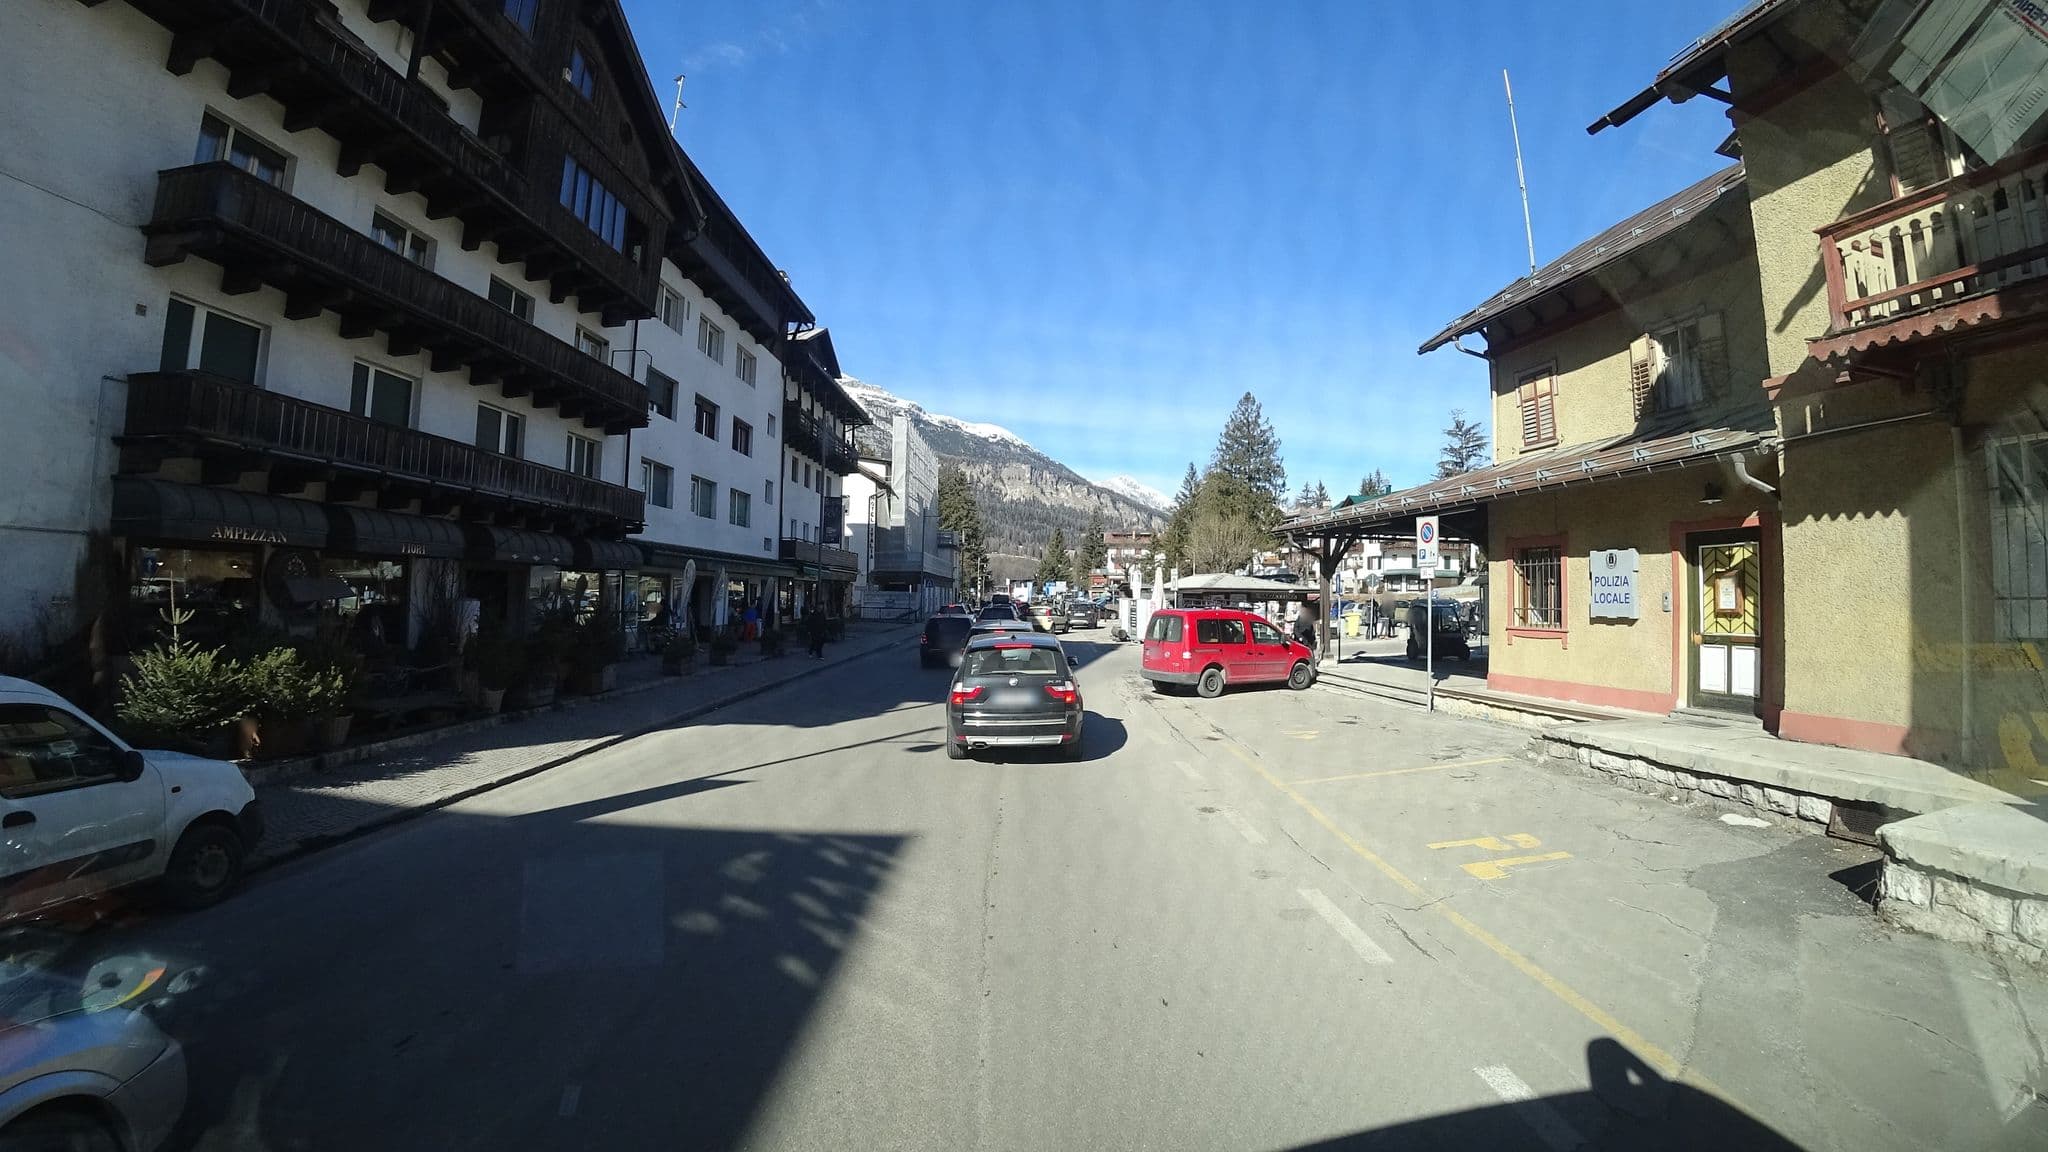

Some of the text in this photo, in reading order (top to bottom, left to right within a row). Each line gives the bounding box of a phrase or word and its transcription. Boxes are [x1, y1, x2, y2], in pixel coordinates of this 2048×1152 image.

[211, 526, 287, 543] AMPEZZAN
[1594, 576, 1629, 587] POLIZIA
[1594, 593, 1630, 604] LOCALE
